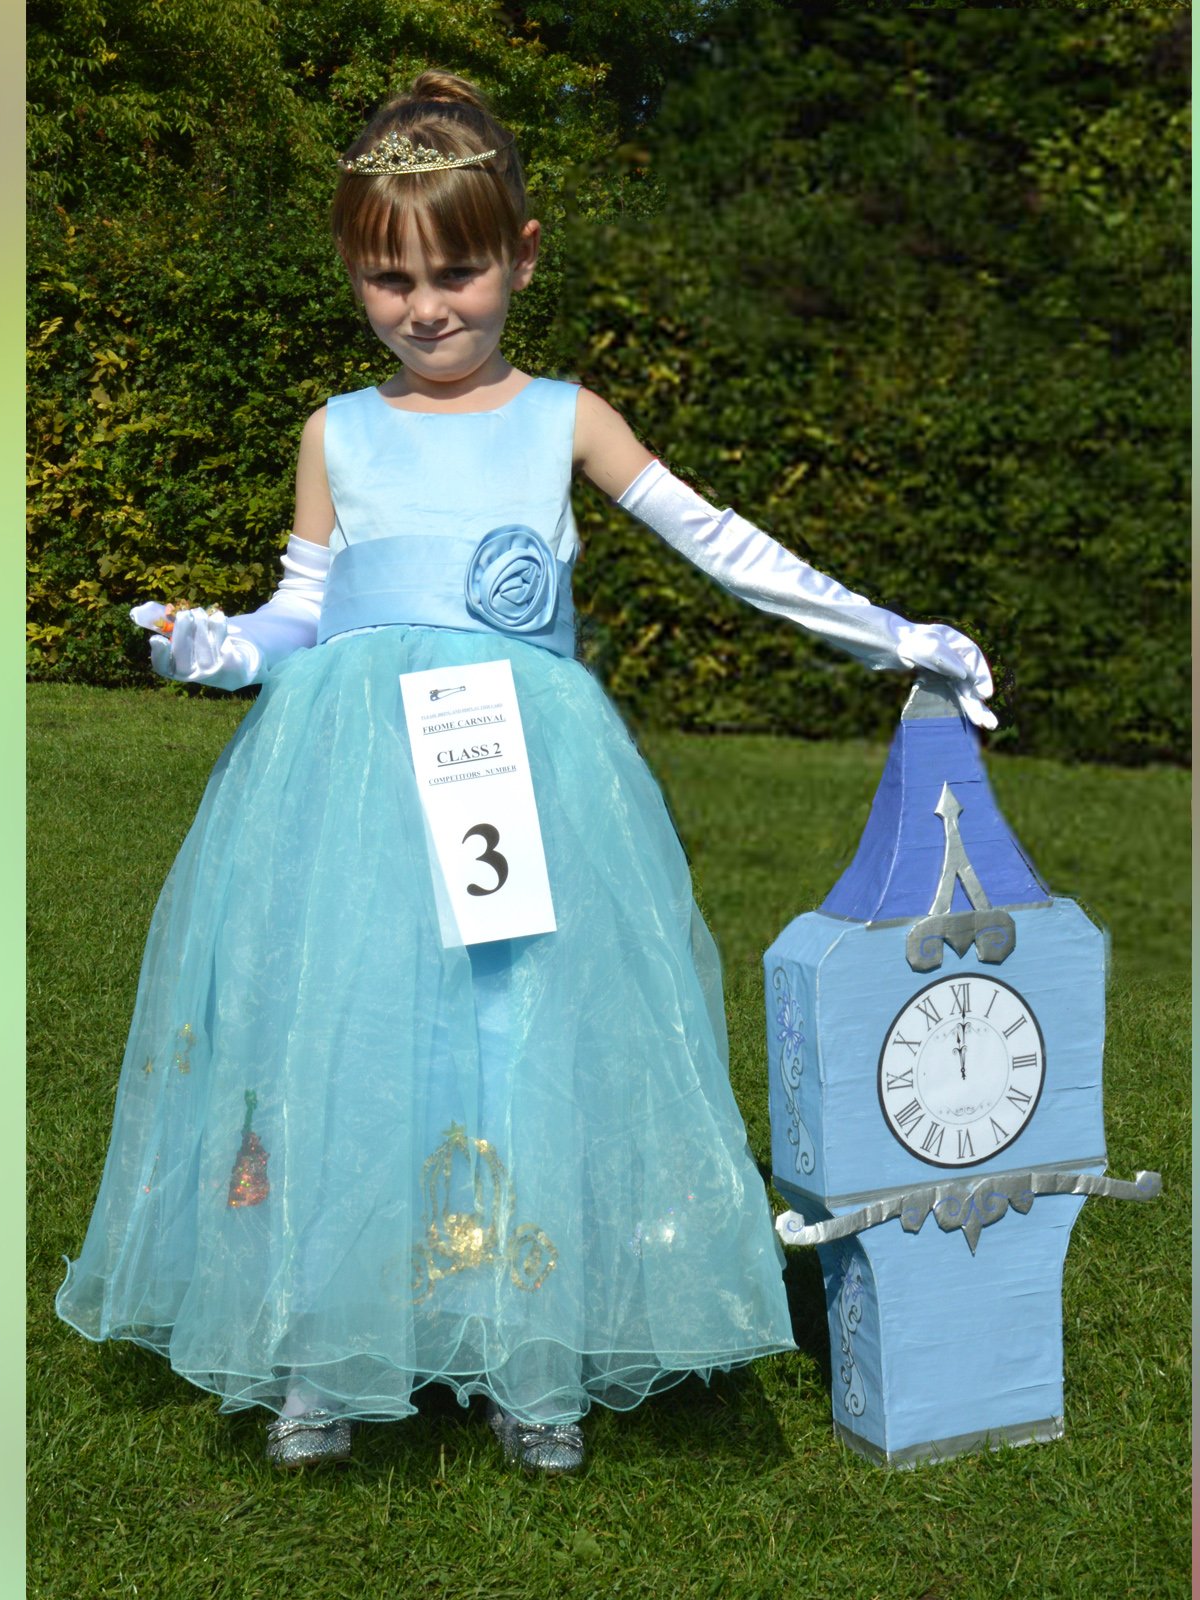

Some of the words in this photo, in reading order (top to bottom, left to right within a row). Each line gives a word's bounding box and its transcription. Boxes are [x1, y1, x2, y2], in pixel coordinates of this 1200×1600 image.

[422, 720, 456, 735] FROME
[457, 713, 506, 728] CARNIVAL
[436, 744, 490, 764] CLASS
[493, 742, 502, 755] 2
[428, 770, 482, 785] COMPETITORS
[485, 764, 517, 776] NUMBER
[461, 823, 509, 897] 3
[914, 995, 943, 1032] XI
[949, 982, 972, 1016] XII
[984, 989, 1000, 1019] I
[1002, 1014, 1028, 1040] II
[893, 1031, 922, 1056] X
[1012, 1052, 1038, 1071] III
[886, 1068, 914, 1093] IX
[1005, 1086, 1032, 1115] IV
[894, 1097, 926, 1139] VIII
[989, 1116, 1010, 1146] V
[920, 1121, 945, 1157] VII
[956, 1128, 976, 1160] VI
